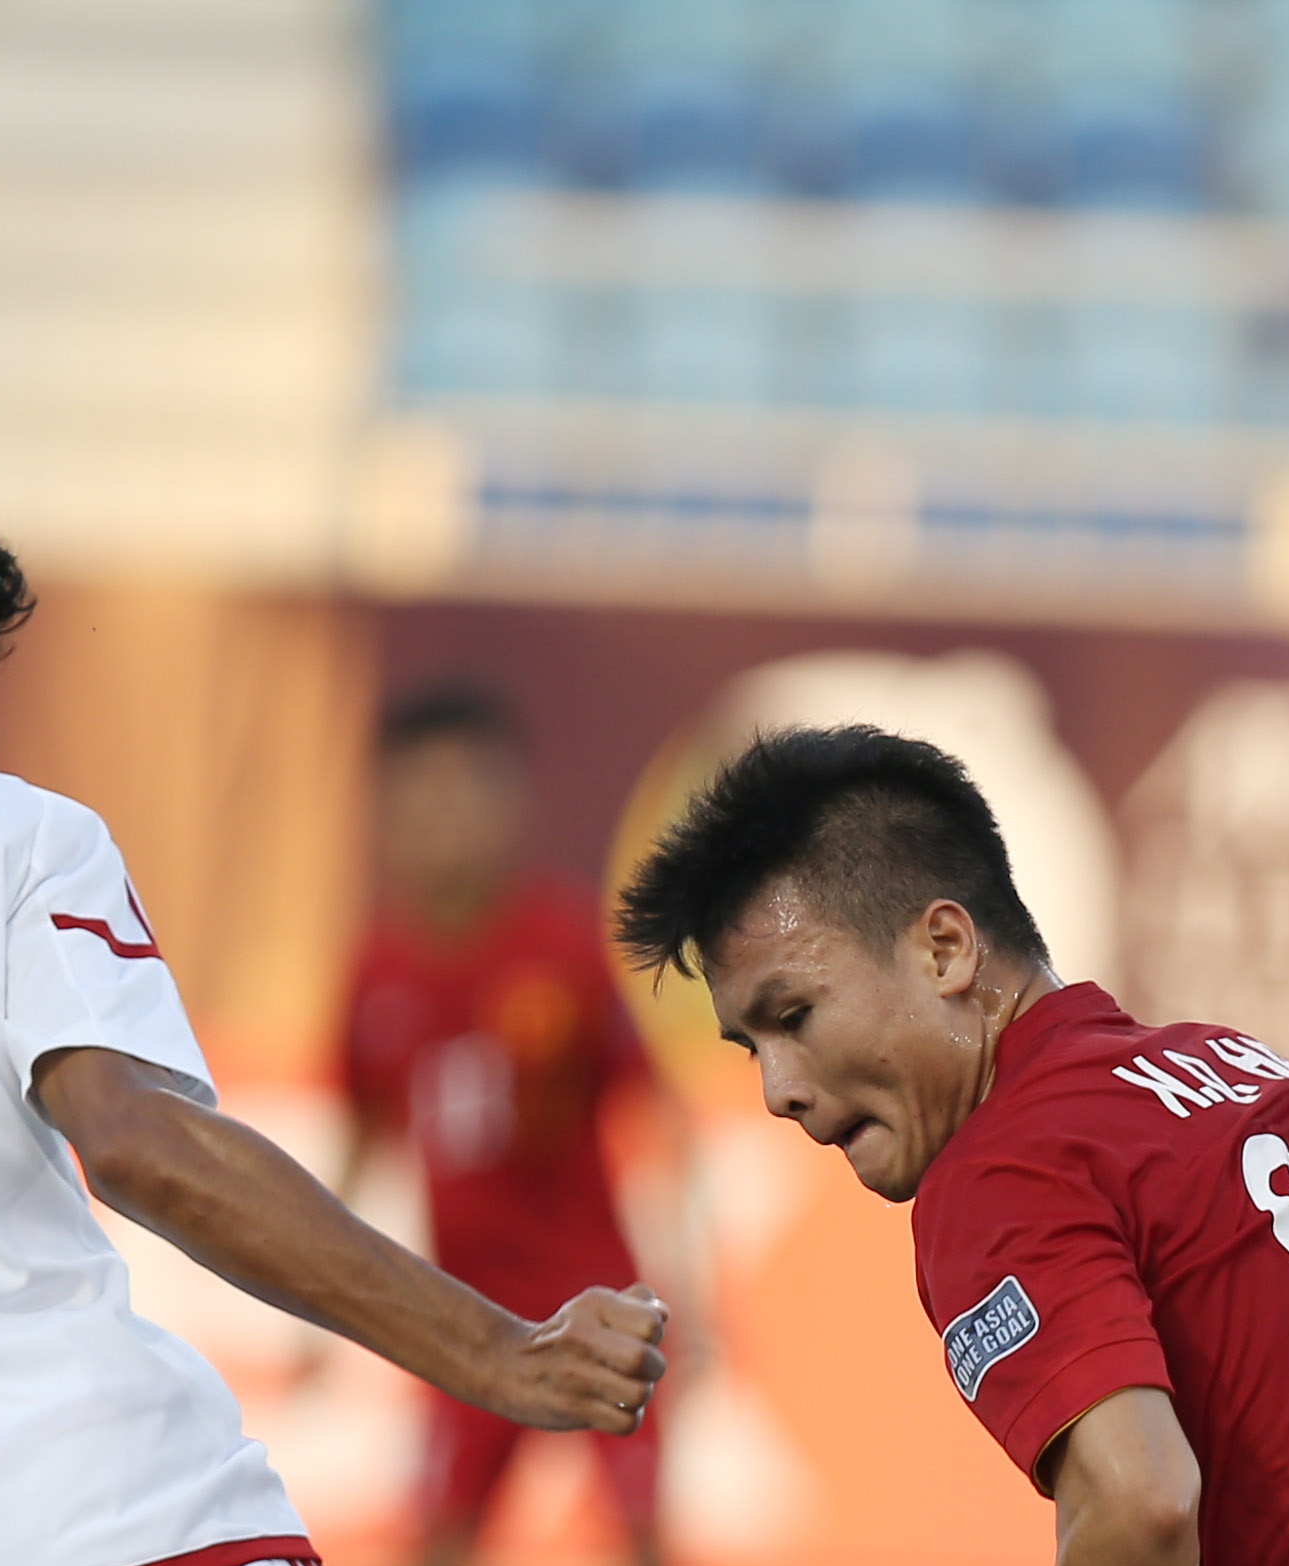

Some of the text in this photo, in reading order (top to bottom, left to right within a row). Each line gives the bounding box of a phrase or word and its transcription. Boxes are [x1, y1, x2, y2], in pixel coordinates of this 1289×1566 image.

[947, 1295, 1018, 1368] ONE ASIA
[956, 1311, 1032, 1387] ONE GOAL
